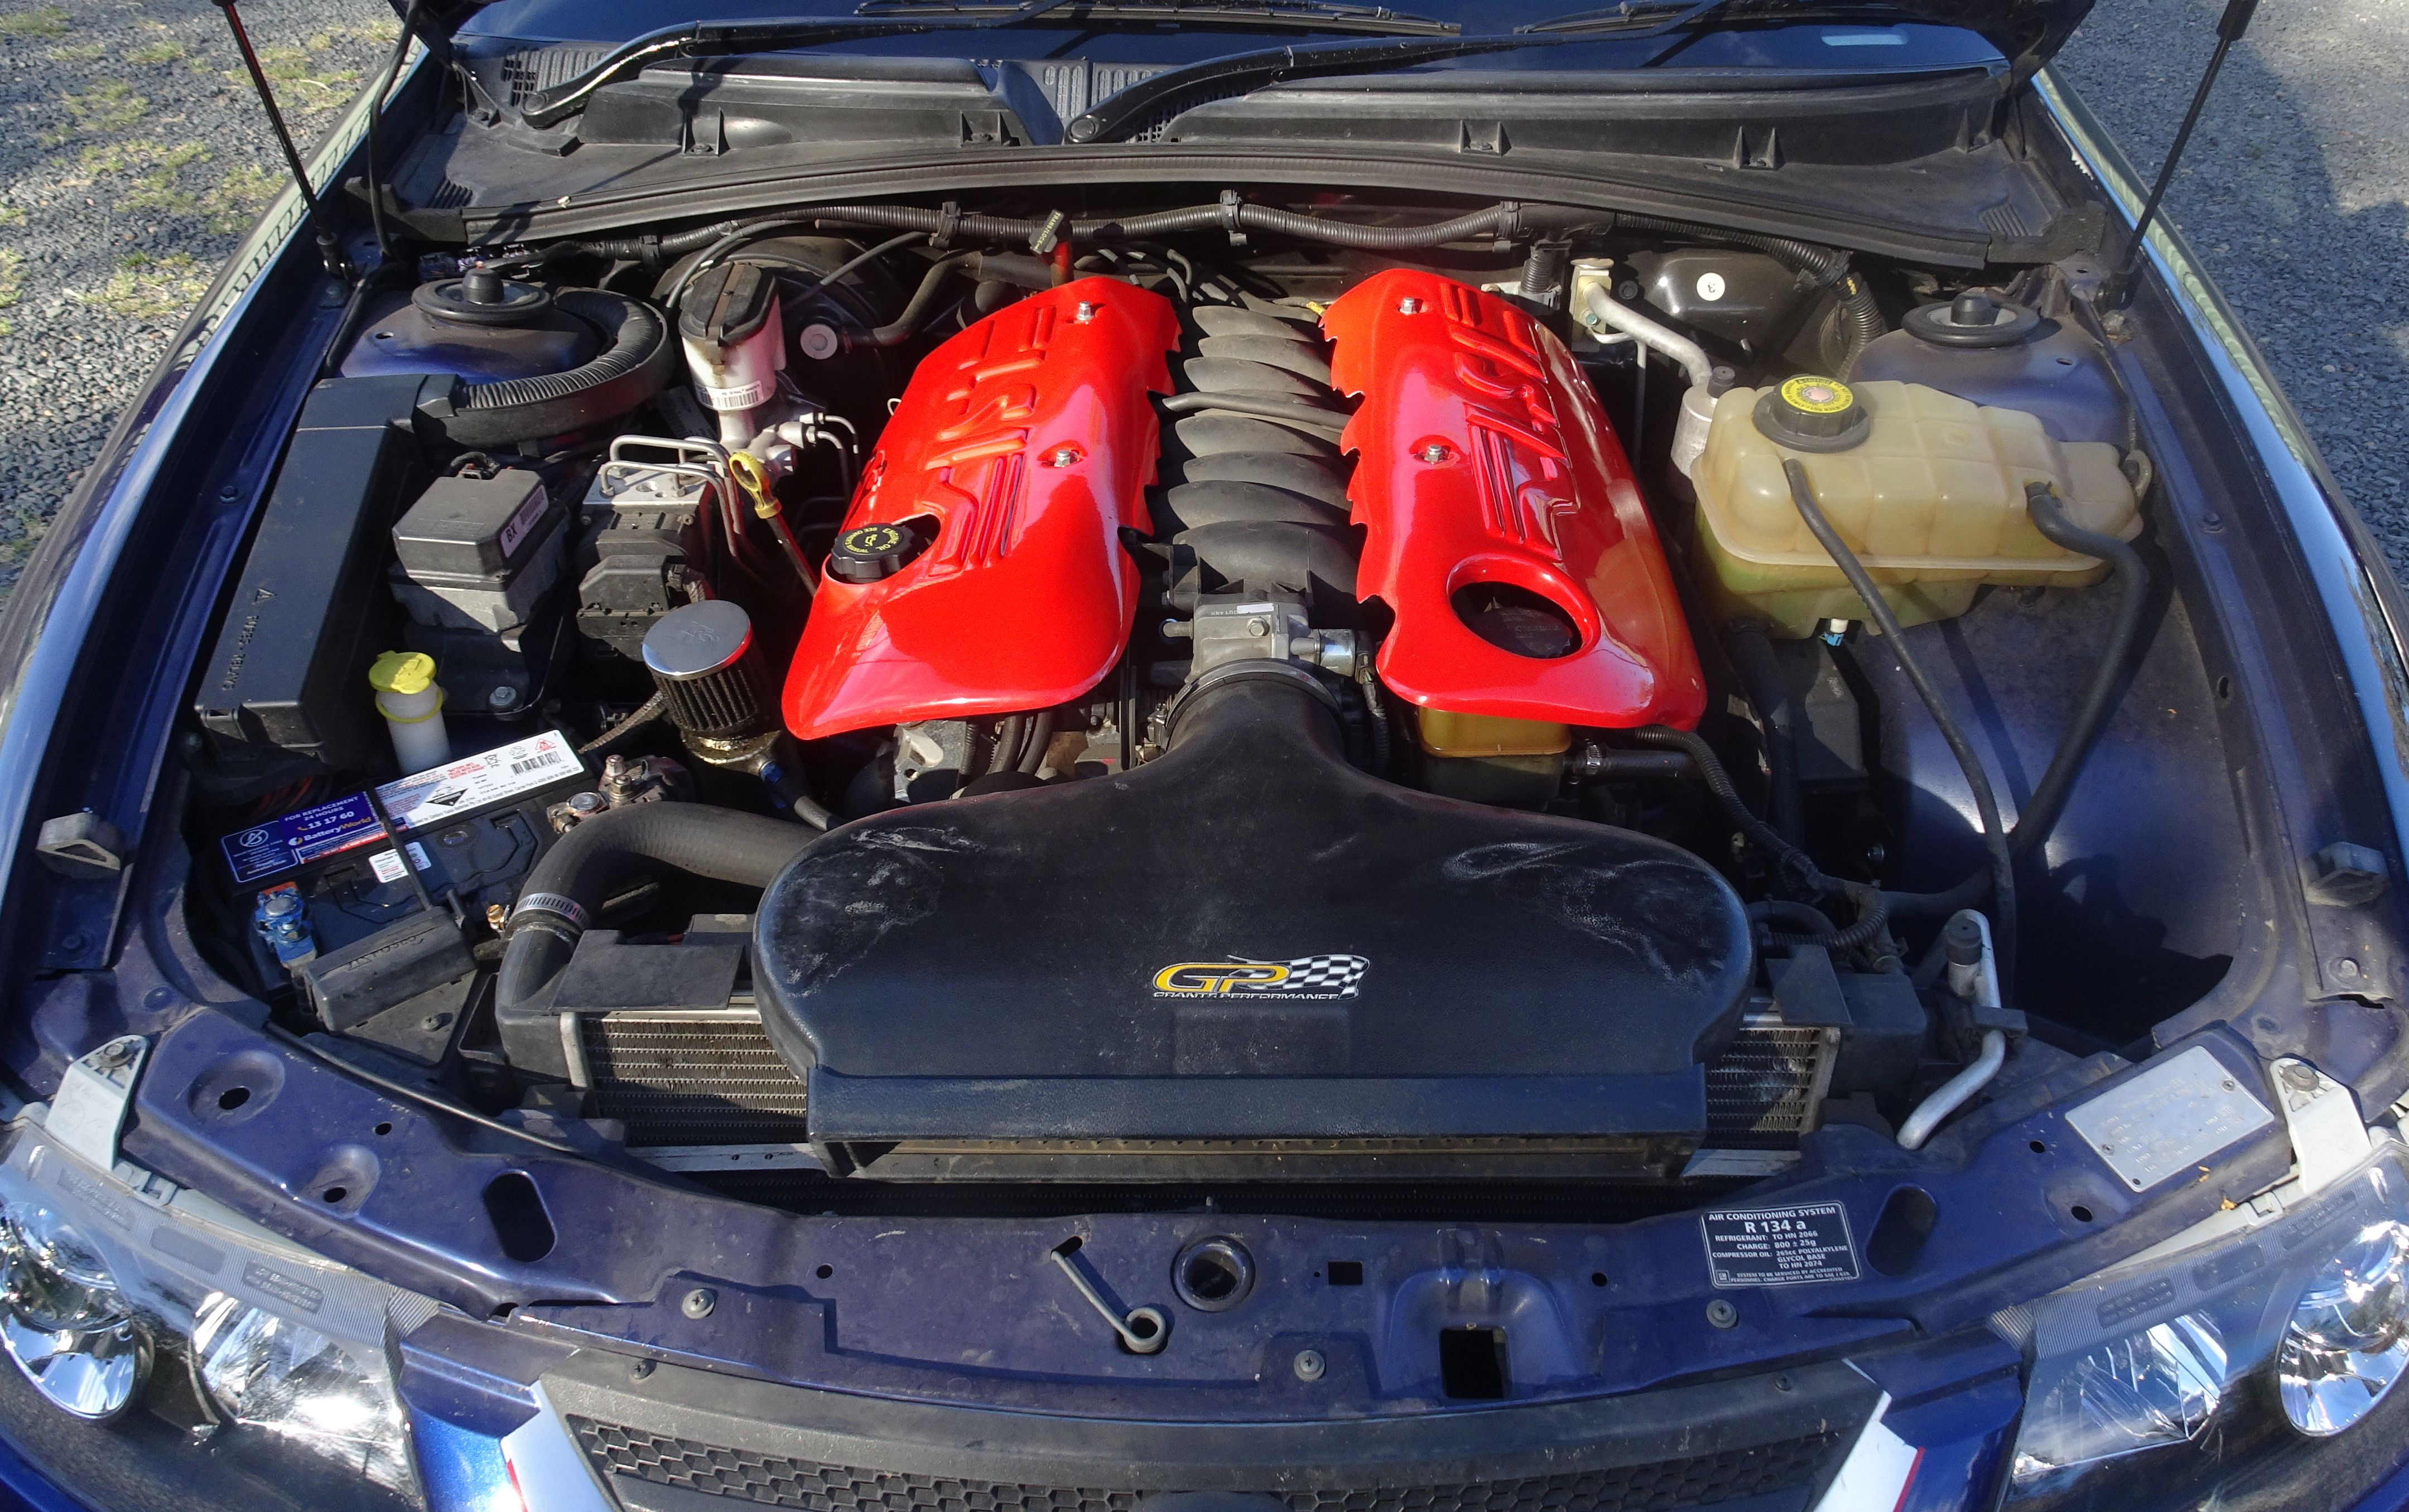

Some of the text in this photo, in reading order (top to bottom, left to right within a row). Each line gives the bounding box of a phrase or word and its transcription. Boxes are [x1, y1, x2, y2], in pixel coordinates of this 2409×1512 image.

[882, 528, 900, 544] ENGINE
[302, 796, 359, 816] REPLACEMENT
[315, 806, 344, 818] HOURS
[308, 811, 355, 829] 13 17 60
[304, 817, 372, 841] BatteryWorld
[1727, 1211, 1796, 1221] CONDITIONING
[1799, 1206, 1836, 1217] SYSTEM
[1745, 1220, 1807, 1233] R 134 a
[1715, 1234, 1769, 1242] REFRIGERANT:
[1798, 1245, 1848, 1254] POLYALKYLENE
